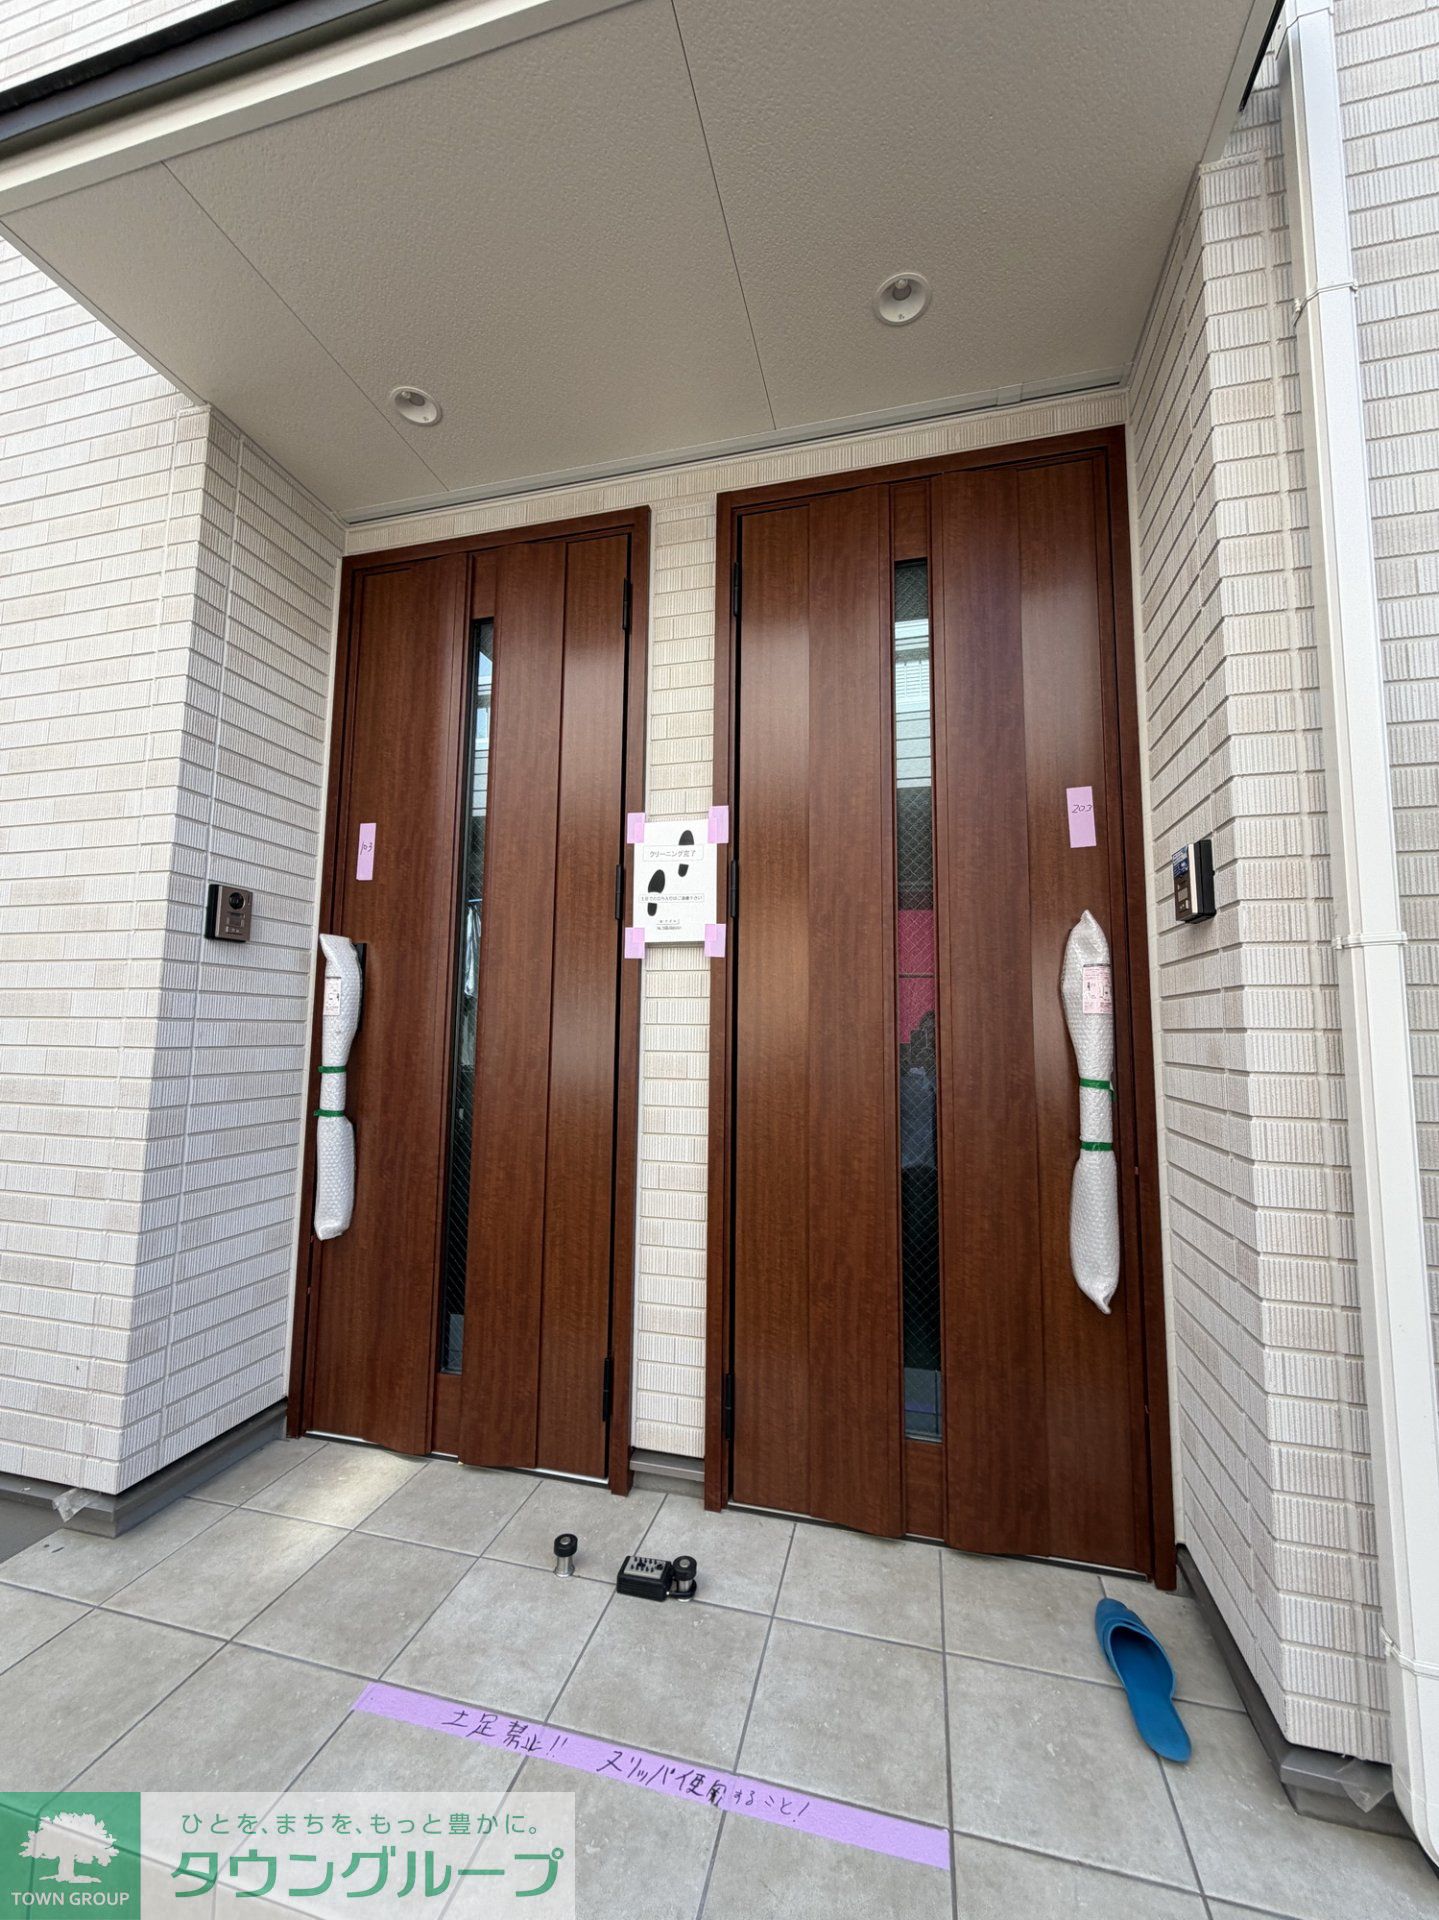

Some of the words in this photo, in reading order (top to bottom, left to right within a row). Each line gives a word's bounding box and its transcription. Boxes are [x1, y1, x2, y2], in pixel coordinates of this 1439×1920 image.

[649, 849, 697, 858] クリーニング完了
